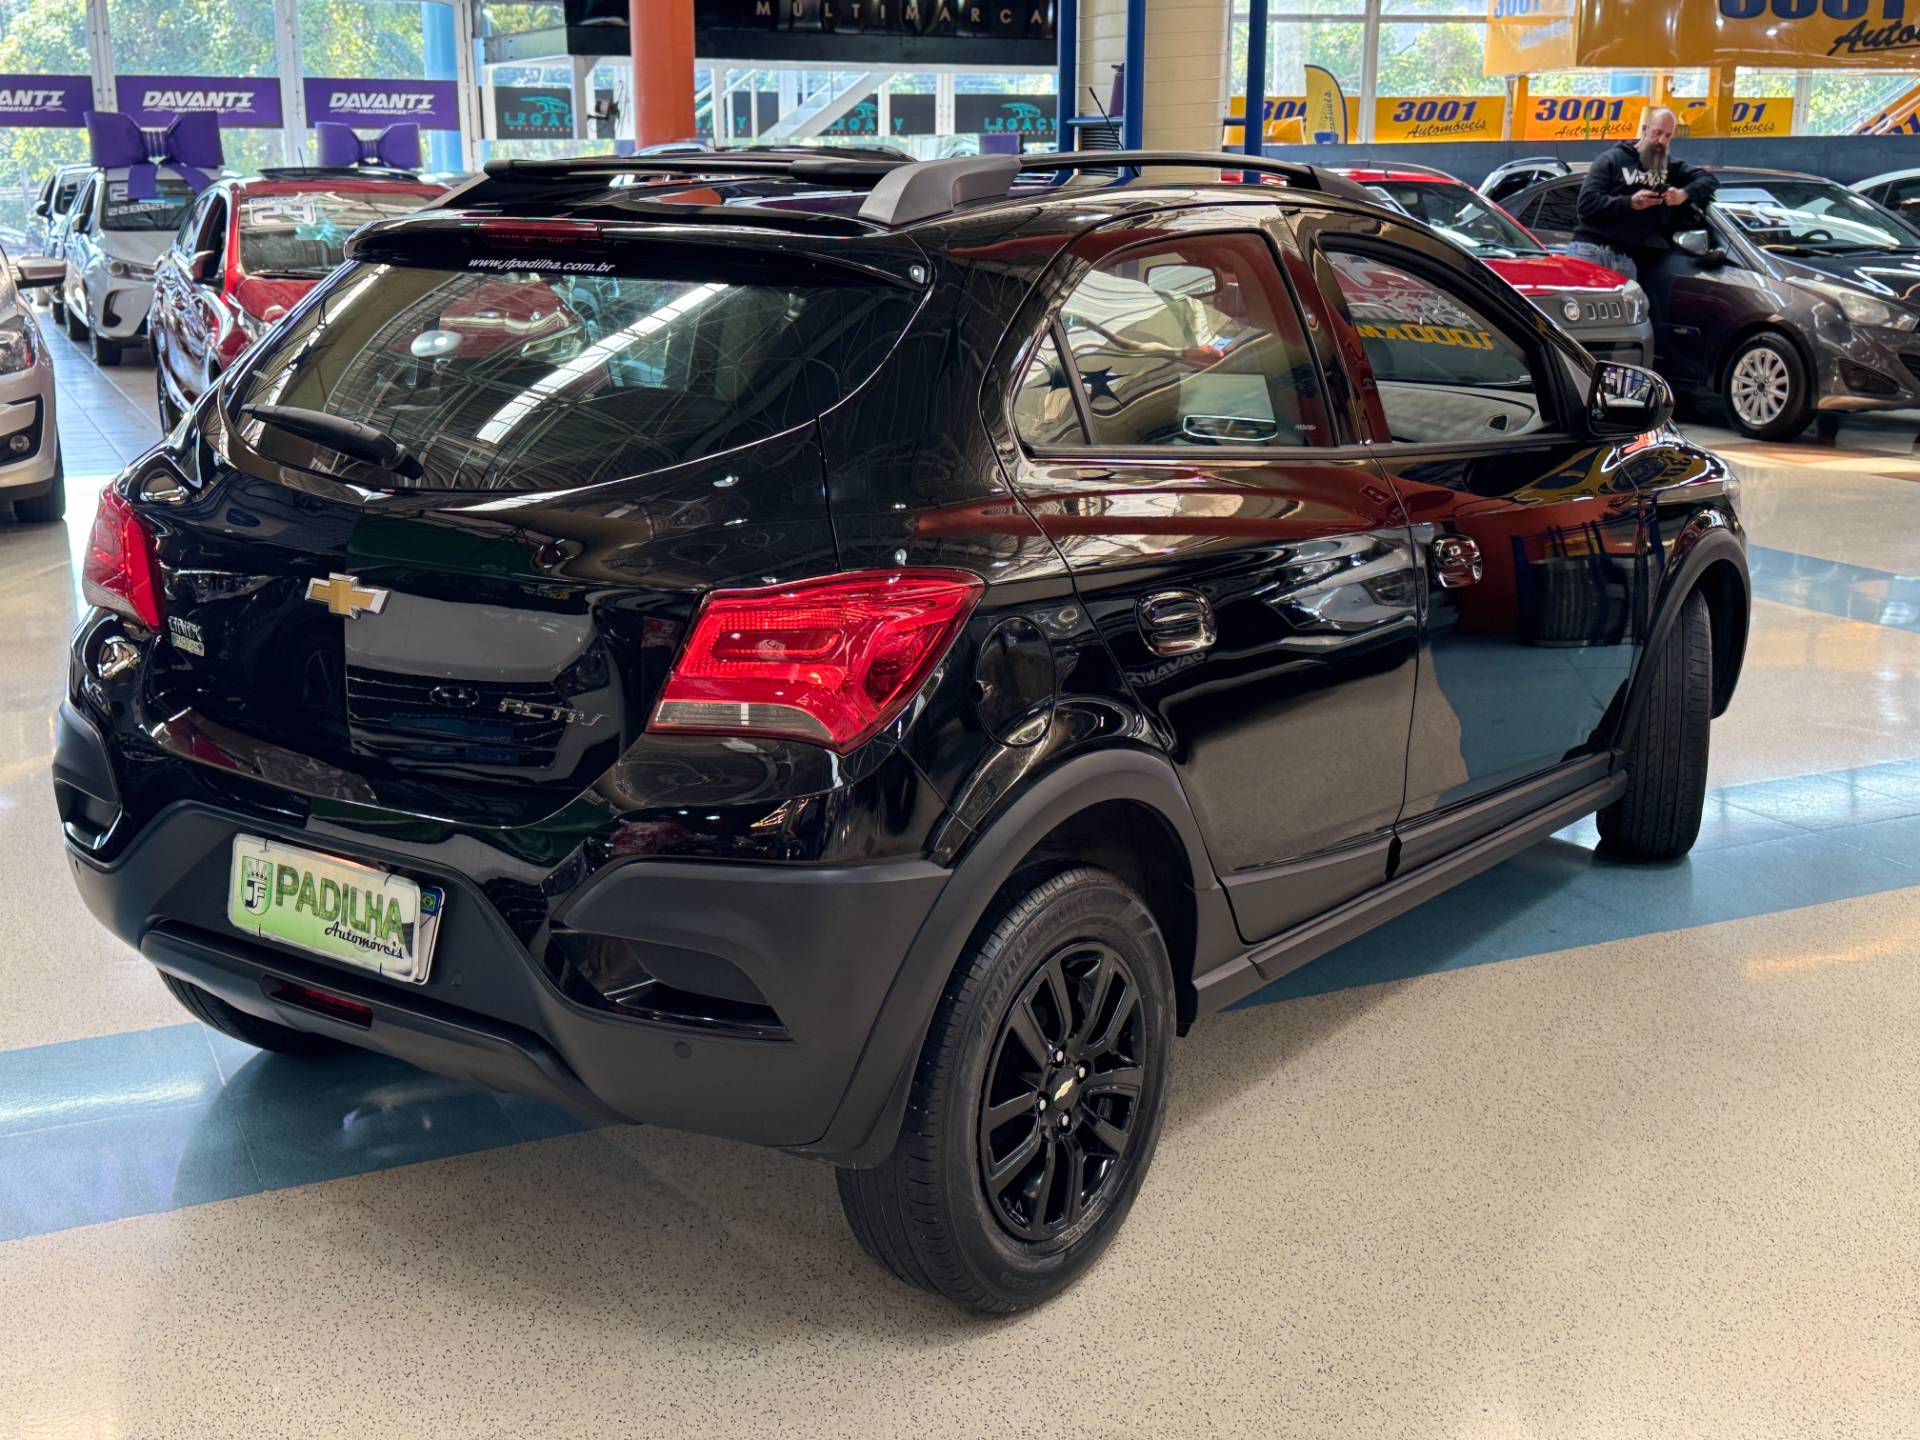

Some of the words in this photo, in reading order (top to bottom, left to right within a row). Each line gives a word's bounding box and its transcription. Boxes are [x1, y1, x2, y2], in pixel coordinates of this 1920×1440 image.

[142, 90, 255, 107] DAVANTI
[329, 92, 435, 109] DAVANTI
[1392, 100, 1478, 122] 3001
[1535, 98, 1624, 121] 3001
[1405, 118, 1486, 139] Automóveis
[468, 258, 616, 273] www.jfpadilha.com.br
[275, 863, 407, 946] PADILHA
[324, 921, 404, 960] Automóveis
